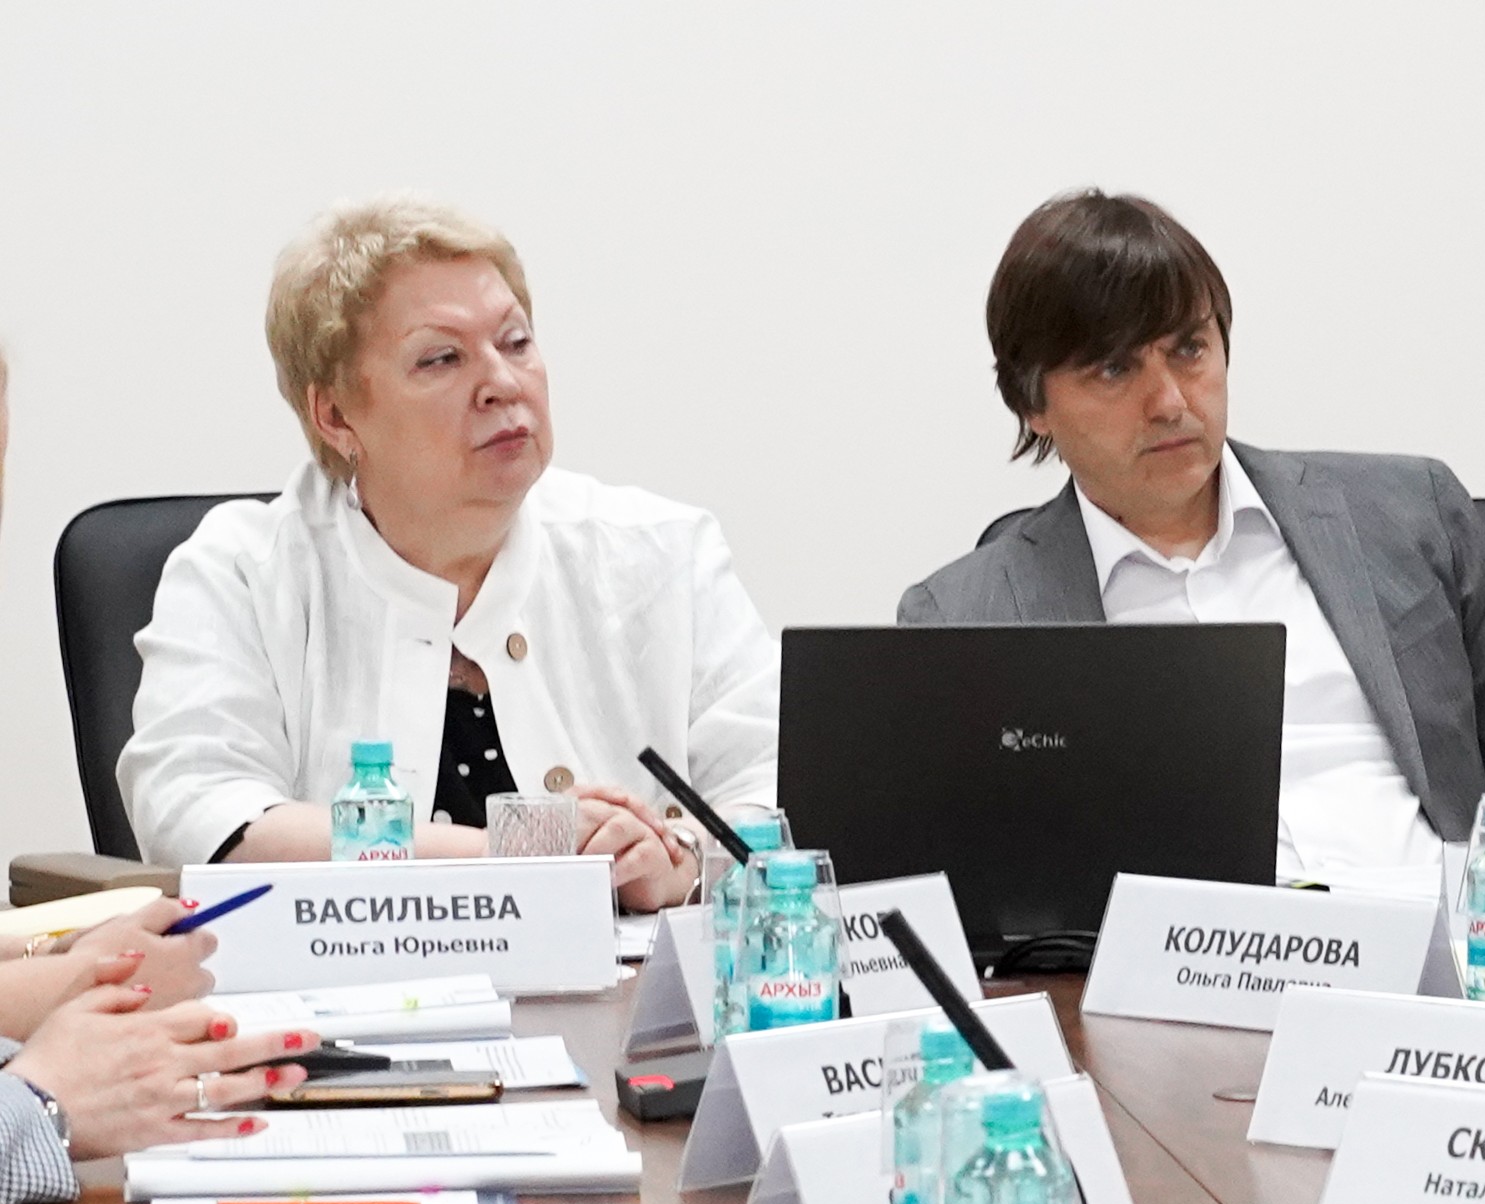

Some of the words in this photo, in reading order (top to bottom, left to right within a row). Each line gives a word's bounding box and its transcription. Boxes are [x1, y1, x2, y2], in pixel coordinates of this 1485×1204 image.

[294, 893, 522, 926] ВАСИЛЬЕВА
[310, 937, 385, 957] Ольга
[394, 936, 510, 958] Юрьевна
[1164, 925, 1360, 968] КОЛУДАРОВА
[760, 981, 822, 998] АРХЫЗ
[1176, 966, 1232, 990] Ольга
